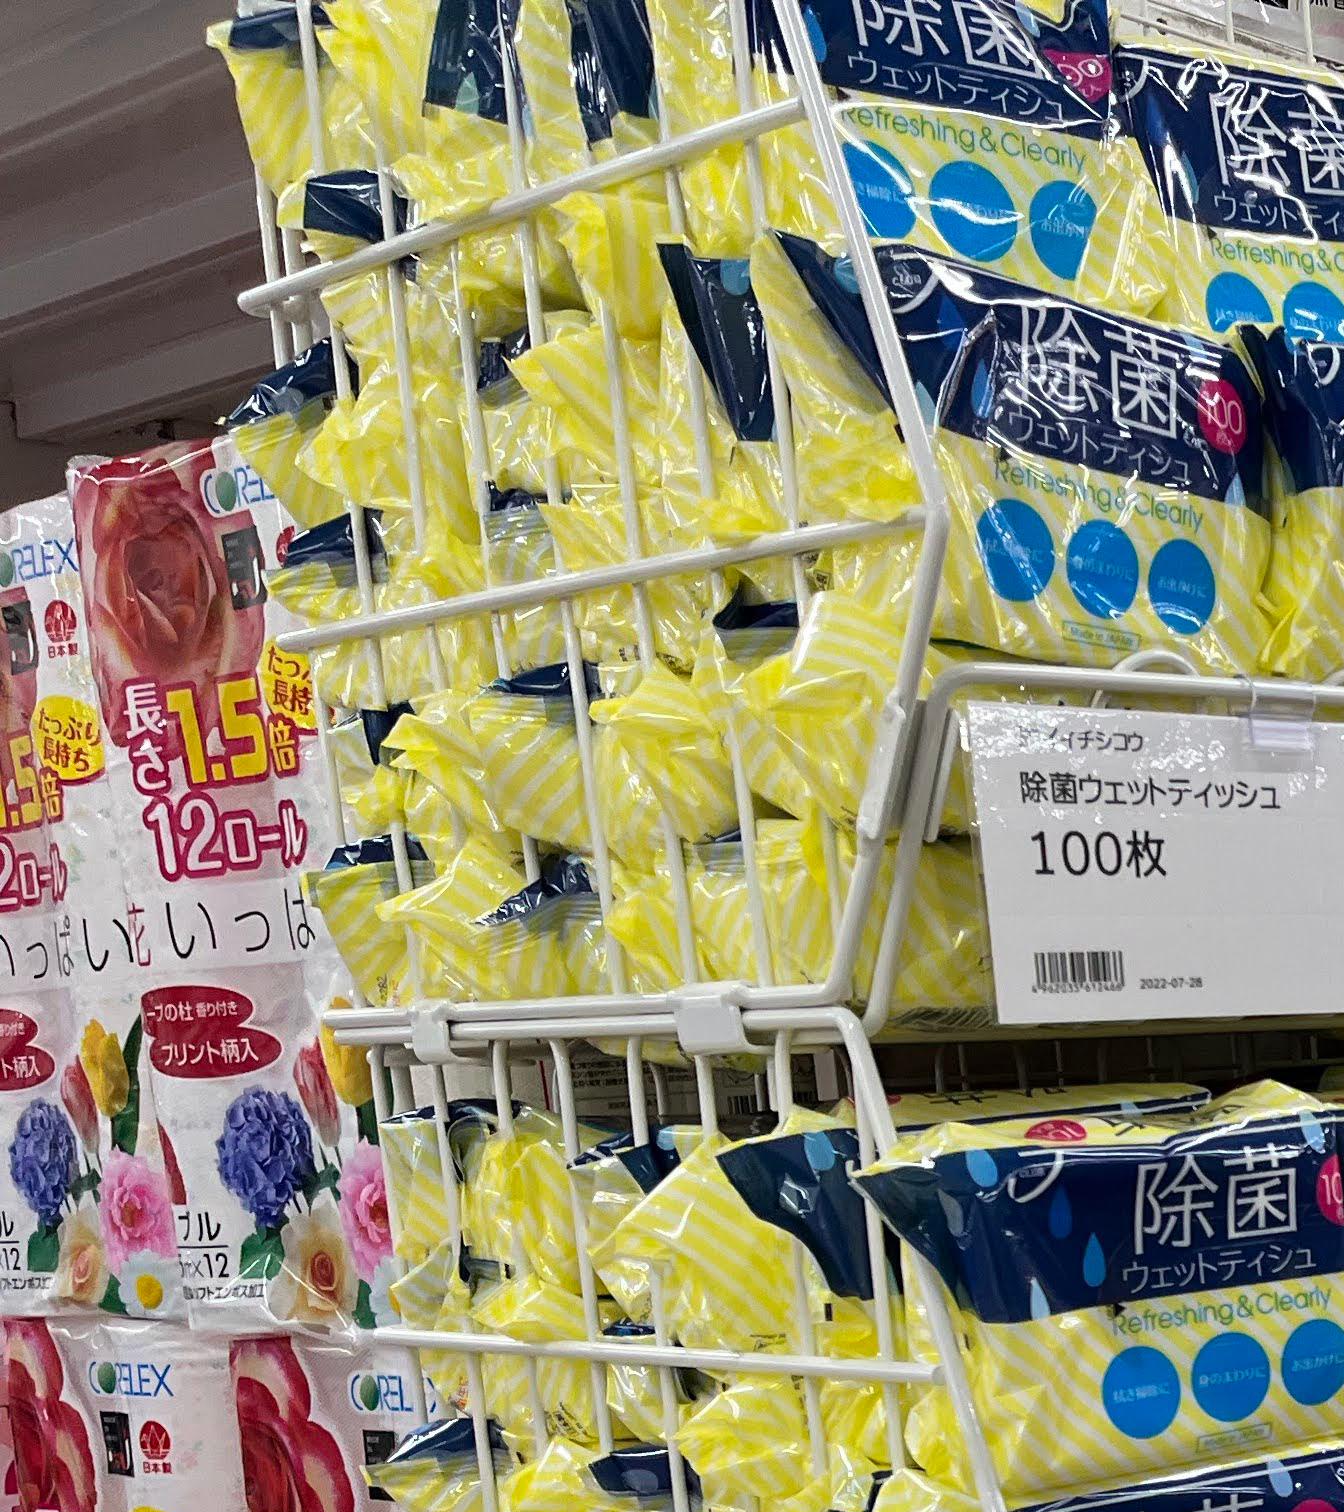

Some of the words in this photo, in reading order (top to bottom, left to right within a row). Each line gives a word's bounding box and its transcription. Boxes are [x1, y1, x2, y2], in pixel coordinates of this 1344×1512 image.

[847, 54, 1065, 124] ウェットティシュ
[1007, 410, 1190, 482] ウェットティシュ
[46, 644, 79, 658] 日本製
[38, 706, 102, 747] たっぷり
[42, 735, 90, 772] 長持ち
[123, 681, 169, 792] 長さ
[144, 798, 308, 881] 12ロール
[1031, 829, 1167, 879] 100枚
[1134, 1143, 1300, 1255] 除菌
[1121, 1245, 1317, 1295] ウェットティシュ
